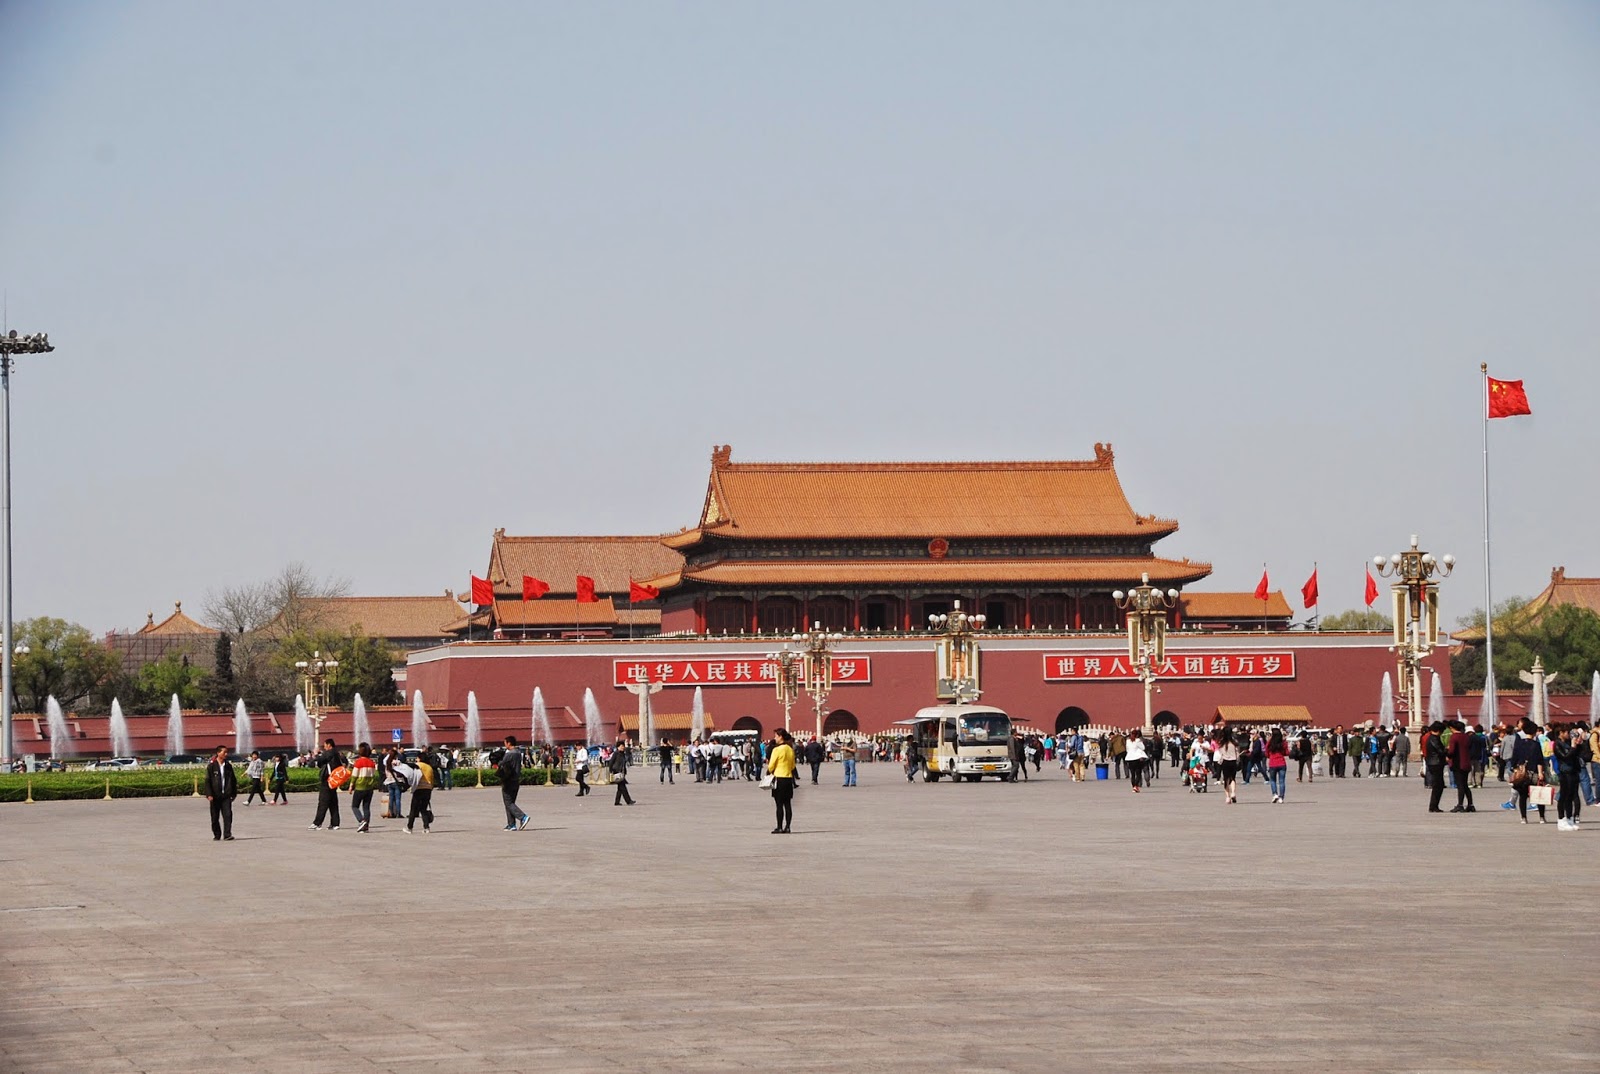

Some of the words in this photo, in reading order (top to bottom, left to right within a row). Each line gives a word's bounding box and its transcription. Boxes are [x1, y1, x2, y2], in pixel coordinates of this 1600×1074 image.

[627, 661, 856, 682] 中华人民共和岁
[1057, 656, 1281, 676] 世界人大团结万岁
